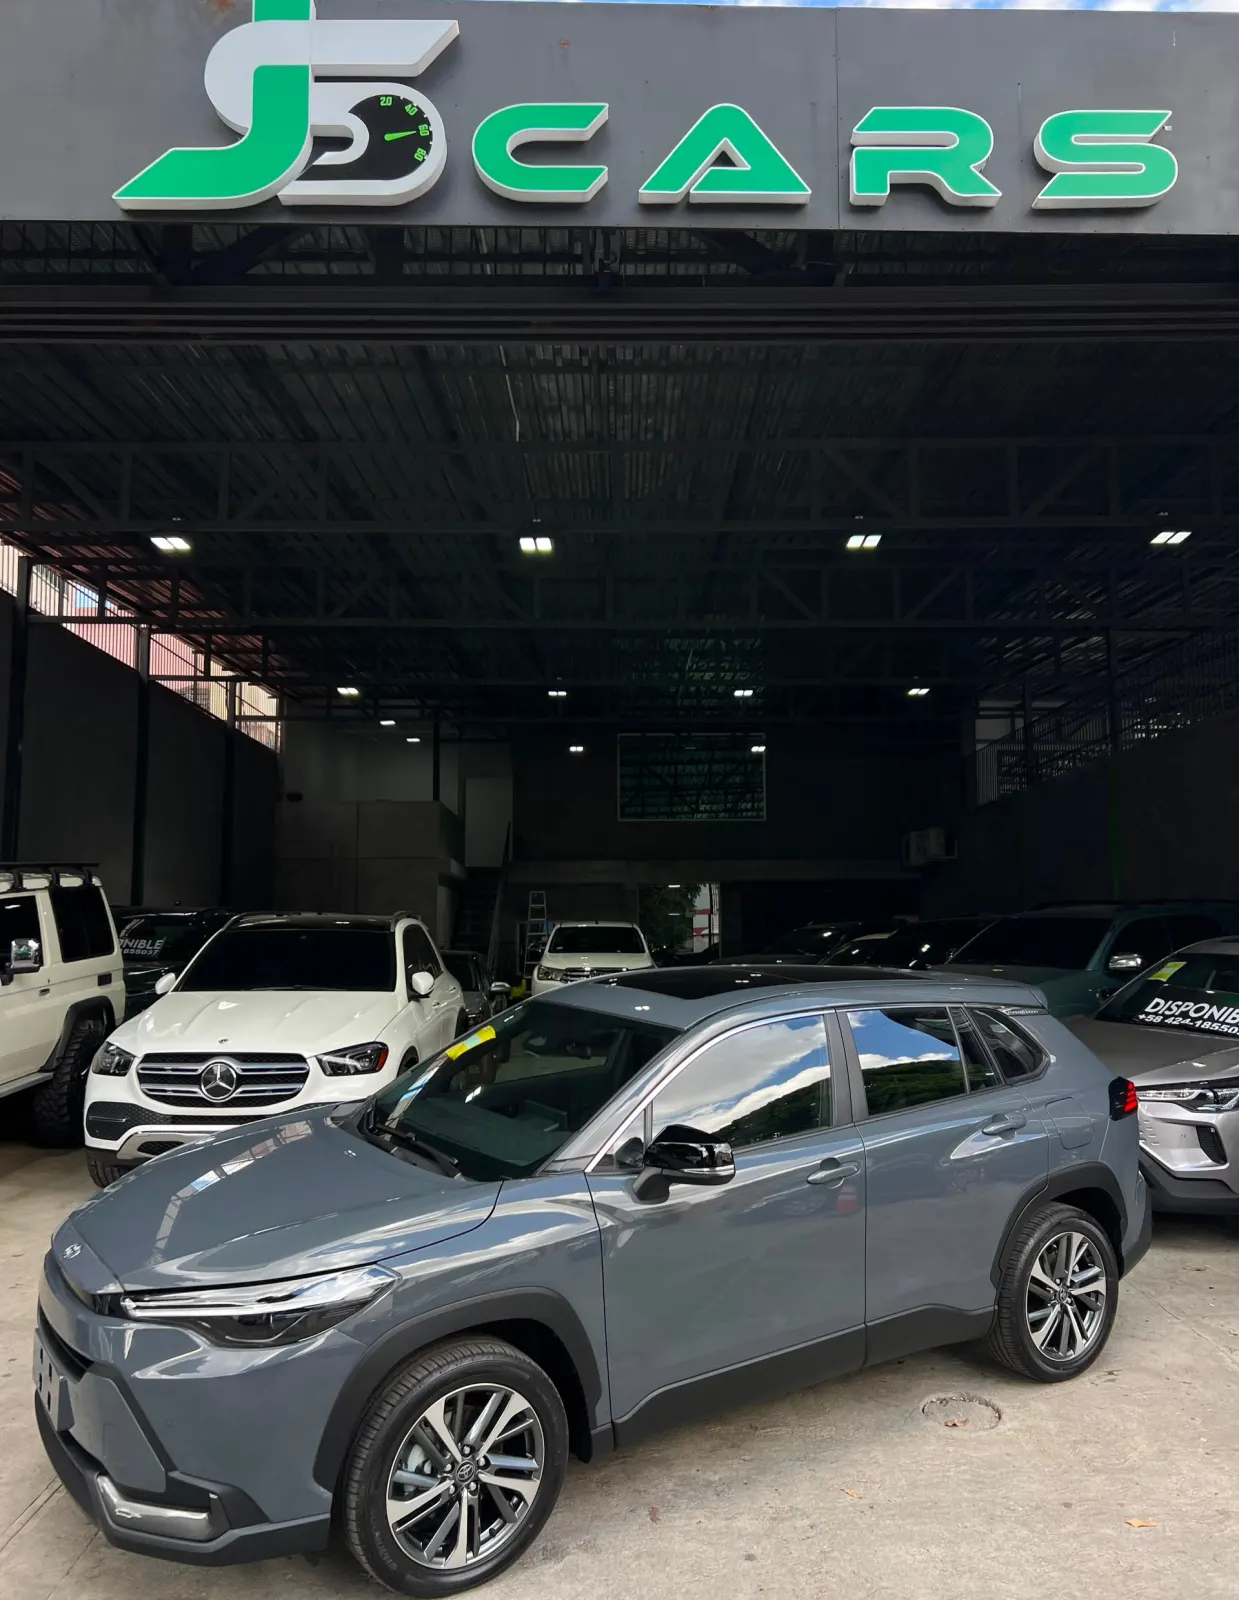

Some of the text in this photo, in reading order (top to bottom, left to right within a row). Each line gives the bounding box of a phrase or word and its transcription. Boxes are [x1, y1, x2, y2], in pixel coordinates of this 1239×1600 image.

[380, 96, 392, 106] 20
[405, 104, 418, 116] 40
[418, 124, 430, 136] 60
[413, 147, 427, 162] 80
[472, 102, 1179, 209] CARS
[1138, 1013, 1239, 1036] +58 424-18550
